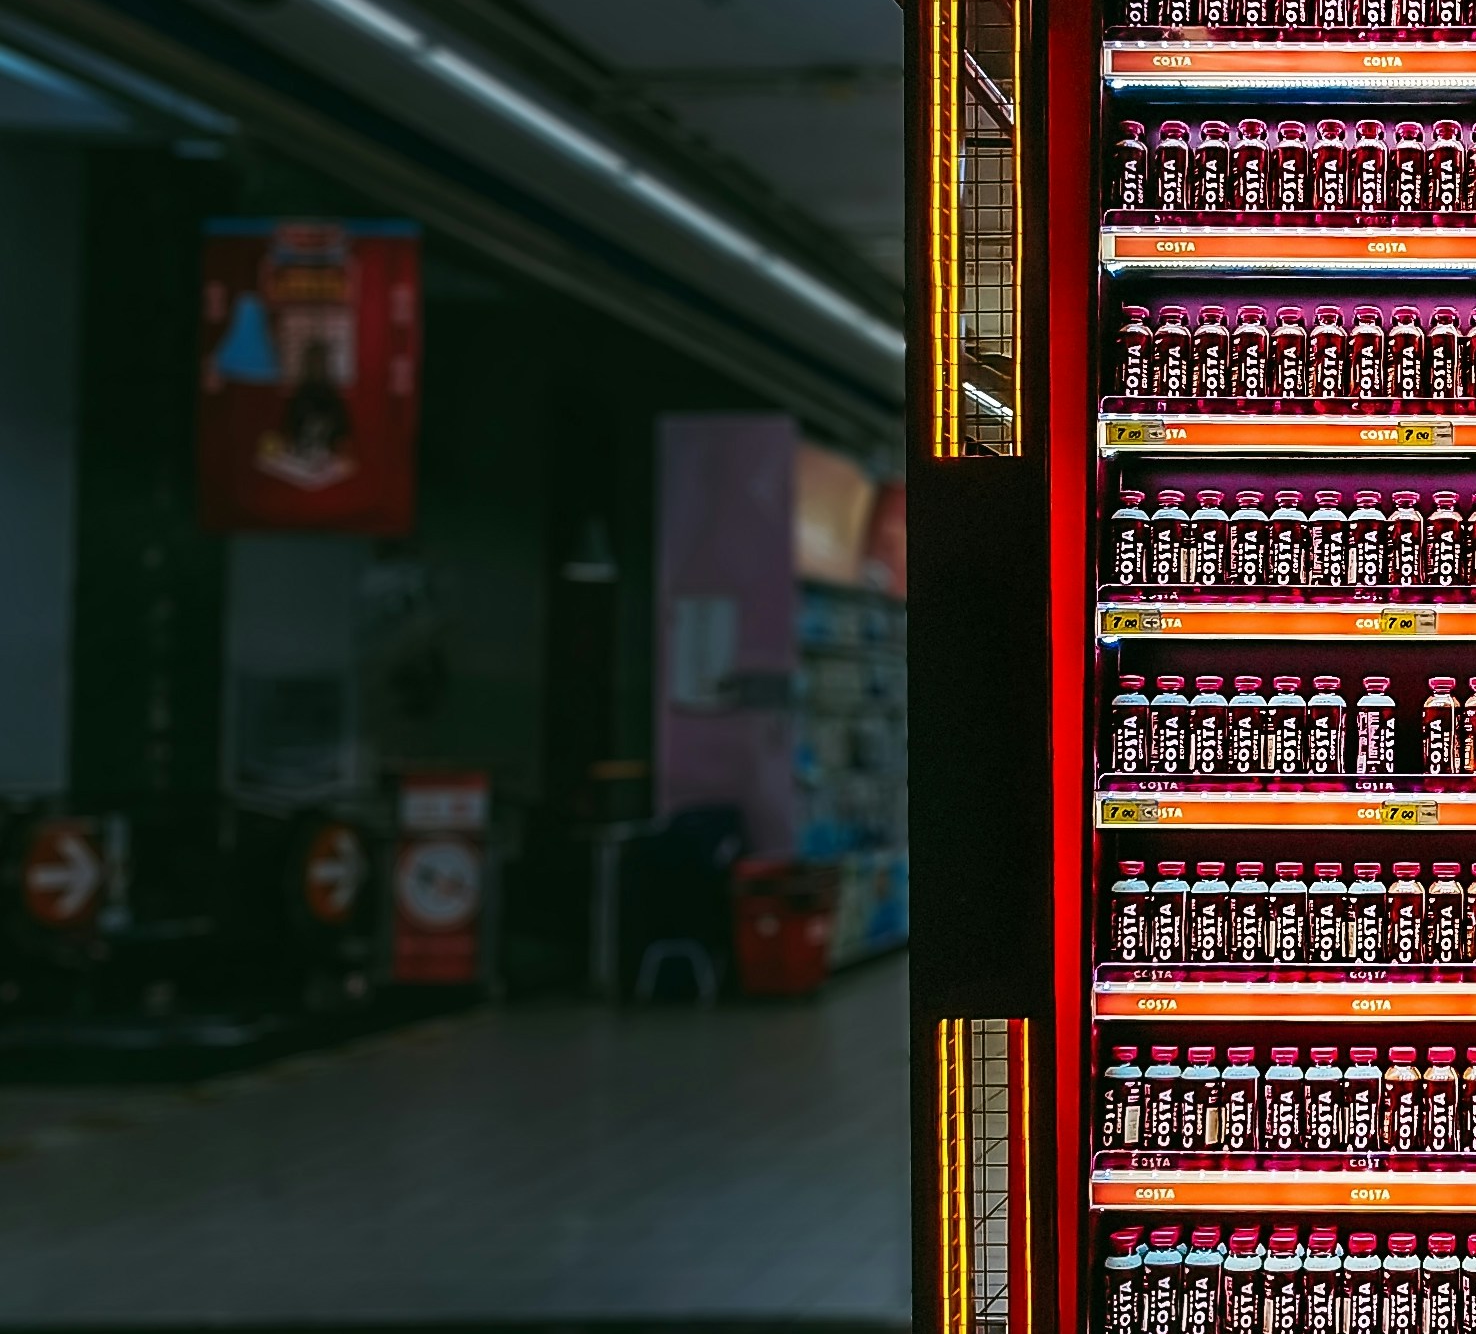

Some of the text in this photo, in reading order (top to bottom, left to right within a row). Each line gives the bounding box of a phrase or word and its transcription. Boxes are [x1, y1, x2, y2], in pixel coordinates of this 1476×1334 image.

[1152, 56, 1192, 68] COSTA
[1363, 56, 1402, 68] COSTA
[1157, 241, 1196, 252] COSTA
[1368, 242, 1407, 254] COSTA
[1117, 428, 1126, 439] 7
[1360, 429, 1398, 441] COSTA
[1404, 429, 1413, 440] 7
[1120, 530, 1134, 586] COSTA
[1157, 531, 1170, 586] COSTA
[1203, 531, 1216, 586] COSTA
[1244, 531, 1257, 586] COSTA
[1277, 531, 1291, 586] COSTA
[1362, 531, 1376, 586] COSTA
[1440, 531, 1453, 586] COSTA
[1113, 616, 1122, 629] 7
[1387, 617, 1397, 629] 7
[1124, 716, 1137, 771] COSTA
[1164, 718, 1178, 772] COSTA
[1200, 717, 1214, 772] COSTA
[1238, 718, 1251, 772] COSTA
[1283, 718, 1296, 772] COSTA
[1316, 718, 1328, 772] COSTA
[1427, 720, 1441, 773] COSTA
[1110, 806, 1119, 818] 7
[1389, 808, 1399, 820] 7
[1123, 904, 1137, 960] COSTA
[1159, 904, 1171, 961] COSTA
[1200, 905, 1214, 960] COSTA
[1243, 905, 1256, 960] COSTA
[1283, 904, 1296, 960] COSTA
[1318, 905, 1332, 961] COSTA
[1361, 905, 1375, 962] COSTA
[1399, 906, 1413, 962] COSTA
[1440, 907, 1452, 962] COSTA
[1138, 999, 1177, 1010] COSTA
[1352, 999, 1391, 1011] COSTA
[1158, 1090, 1171, 1146] COSTA
[1231, 1091, 1245, 1148] COSTA
[1279, 1091, 1293, 1149] COSTA
[1318, 1091, 1332, 1148] COSTA
[1355, 1091, 1369, 1148] COSTA
[1401, 1093, 1415, 1149] COSTA
[1136, 1188, 1175, 1200] COSTA
[1351, 1188, 1390, 1200] COSTA
